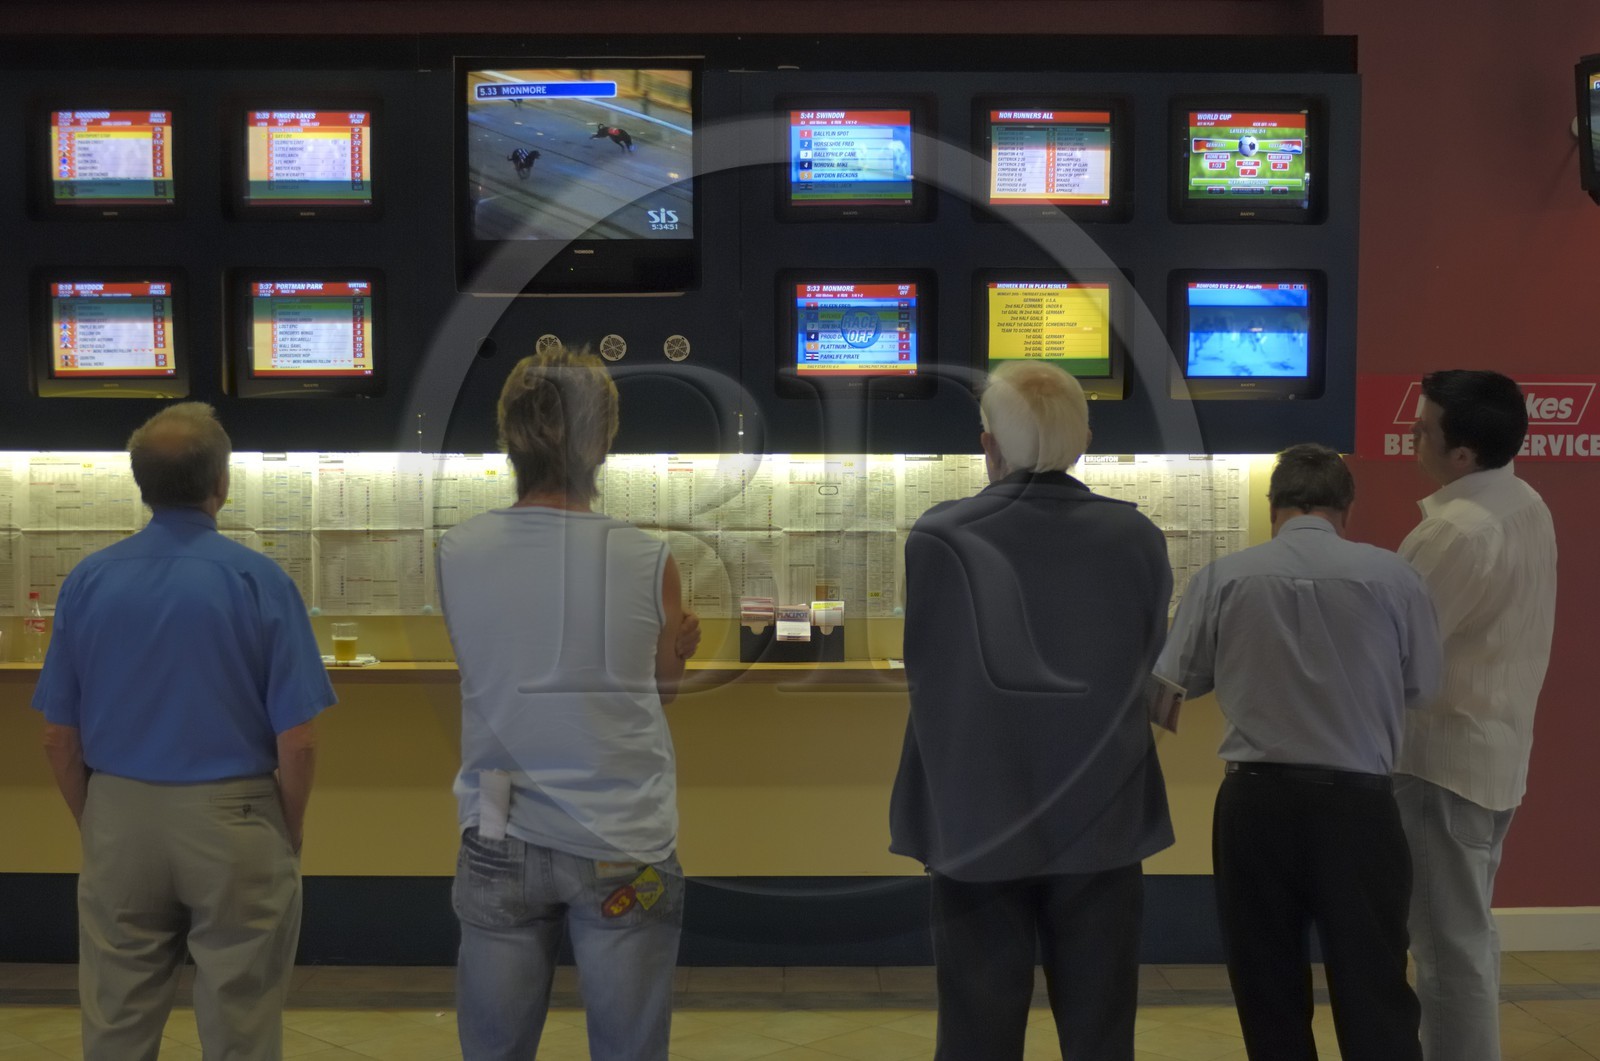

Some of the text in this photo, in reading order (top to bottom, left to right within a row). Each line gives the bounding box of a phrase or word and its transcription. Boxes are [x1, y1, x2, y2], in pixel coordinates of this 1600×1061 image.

[480, 86, 547, 96] 5.33 MONMORE
[843, 315, 876, 328] RACE
[847, 330, 873, 343] OFF
